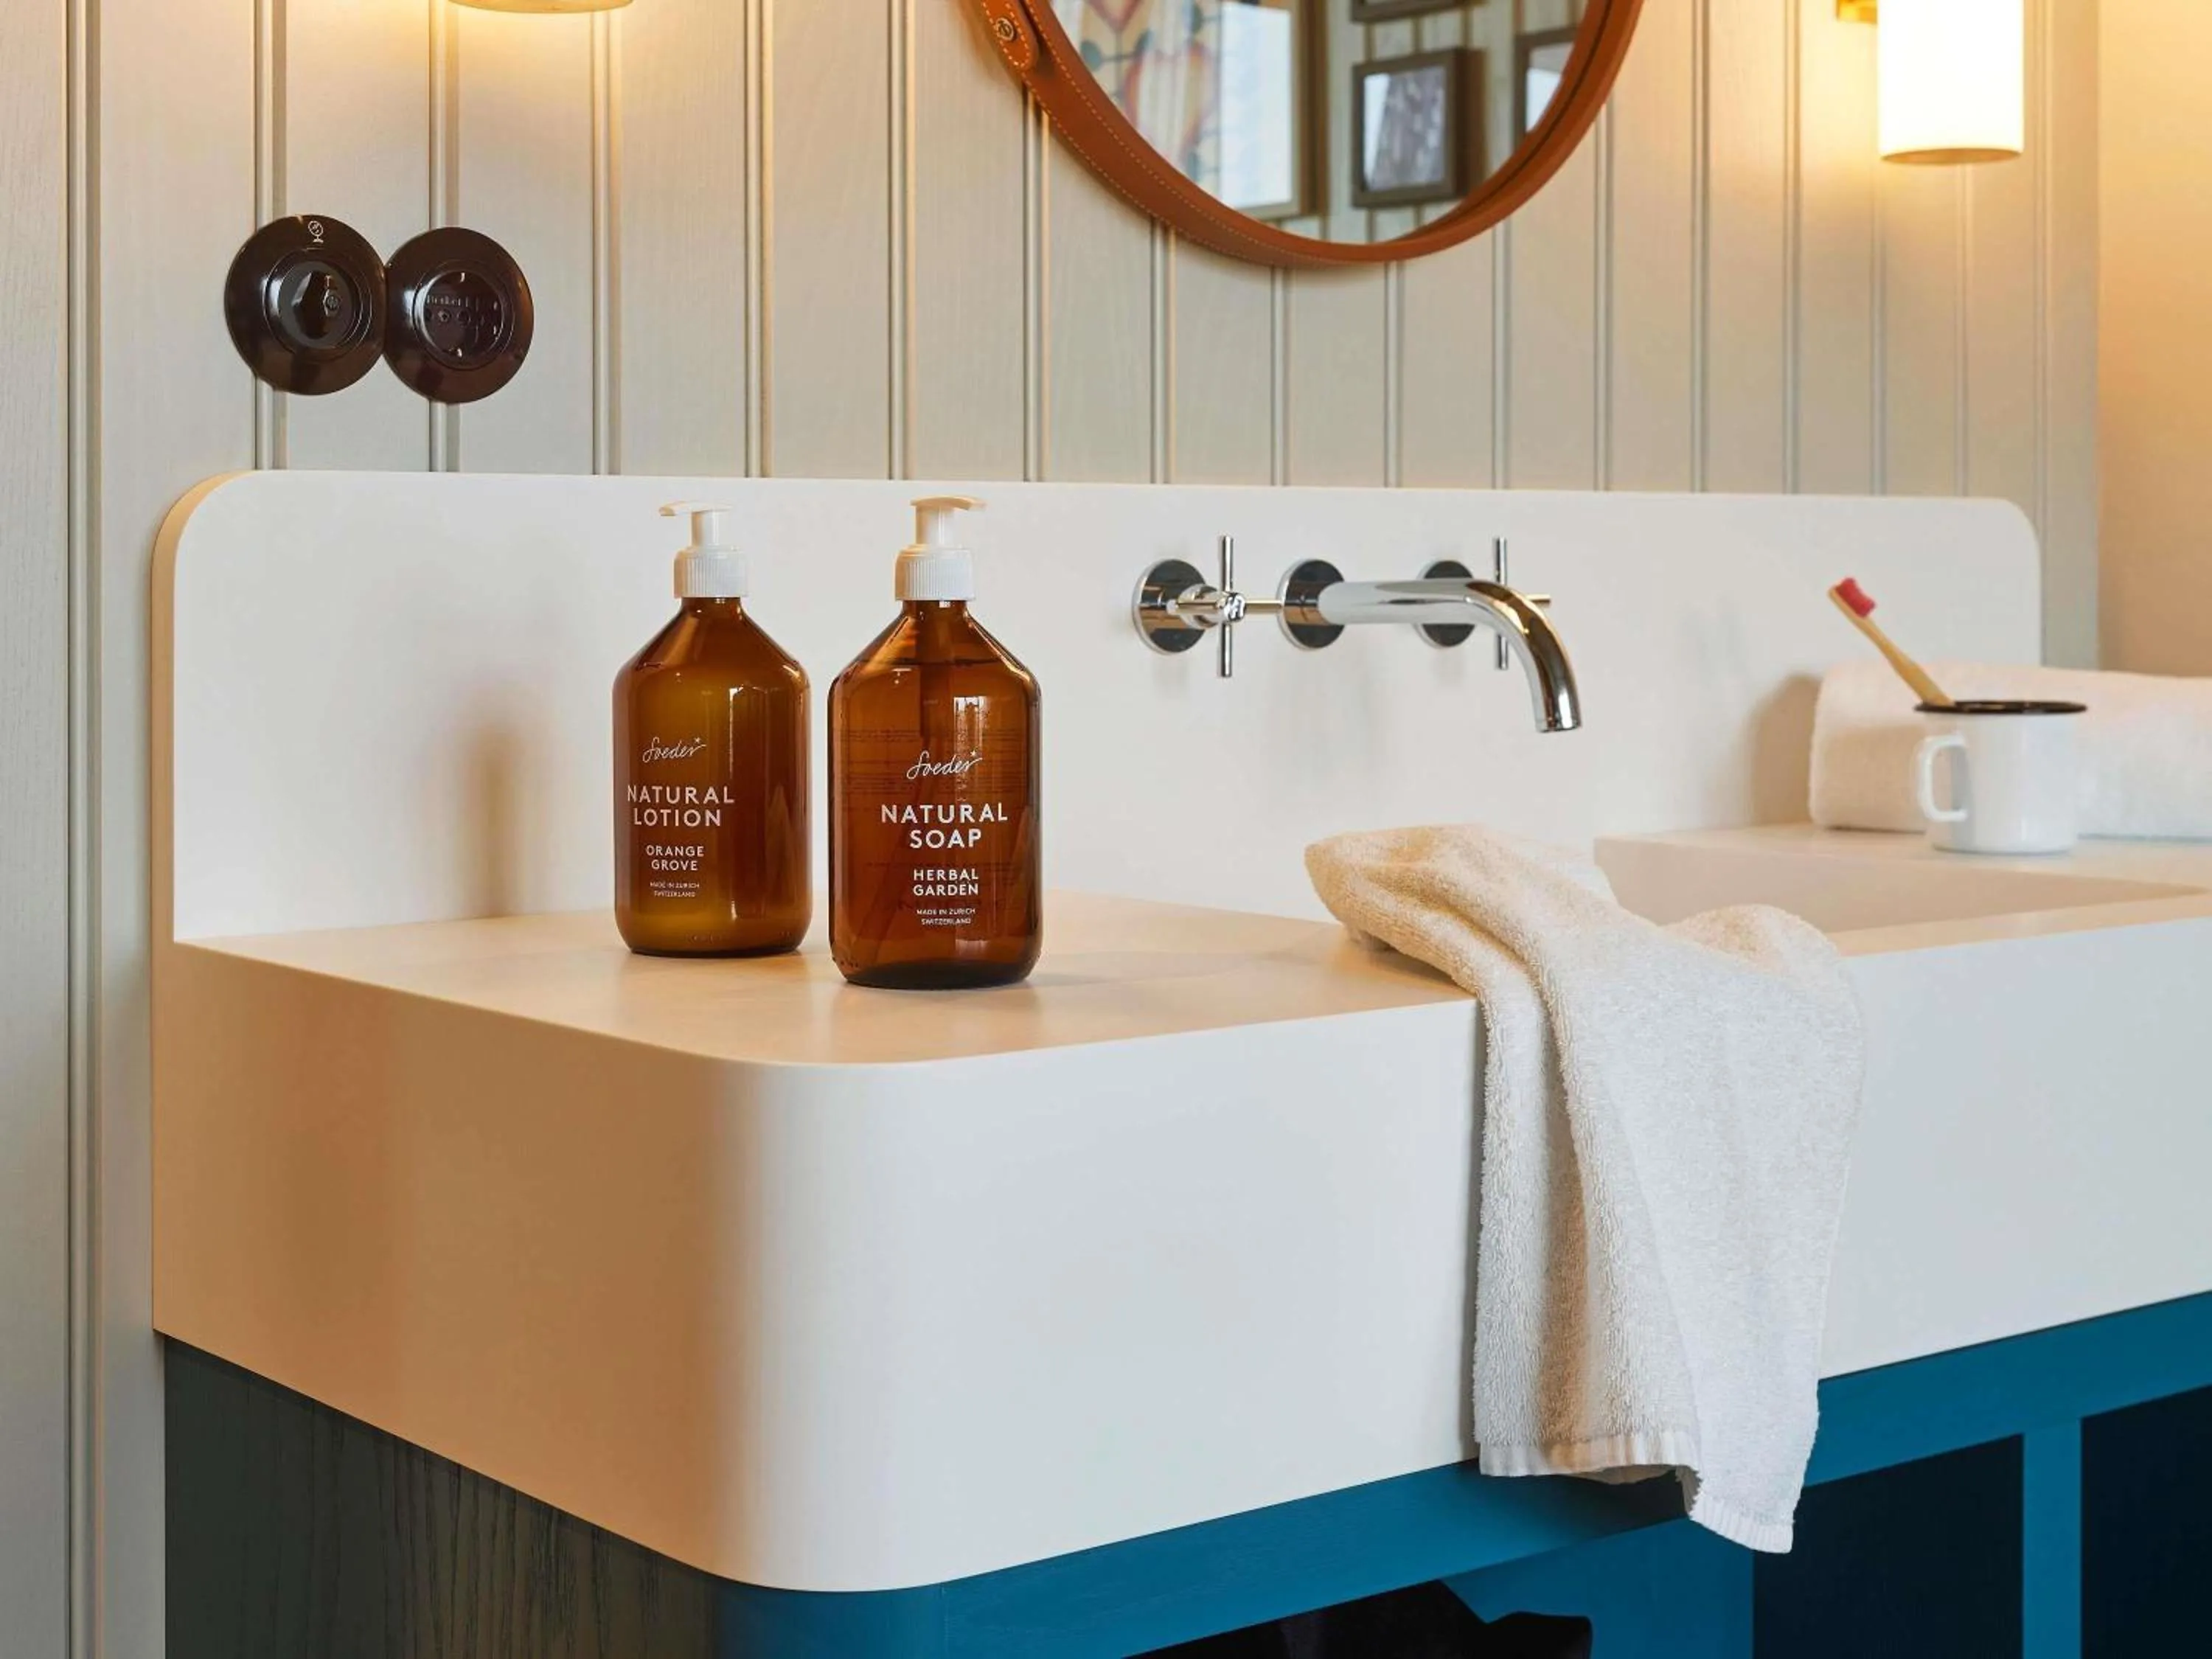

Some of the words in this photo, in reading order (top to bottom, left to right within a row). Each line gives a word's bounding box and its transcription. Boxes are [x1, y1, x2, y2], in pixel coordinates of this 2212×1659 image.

[627, 784, 735, 804] NATURAL
[633, 808, 721, 827] LOTION
[881, 802, 1008, 824] NATURAL
[909, 828, 982, 849] SOAP
[646, 844, 705, 858] ORANGE
[651, 859, 699, 871] GROVE
[913, 869, 979, 881] HERBAL
[913, 883, 979, 896] GARDEN
